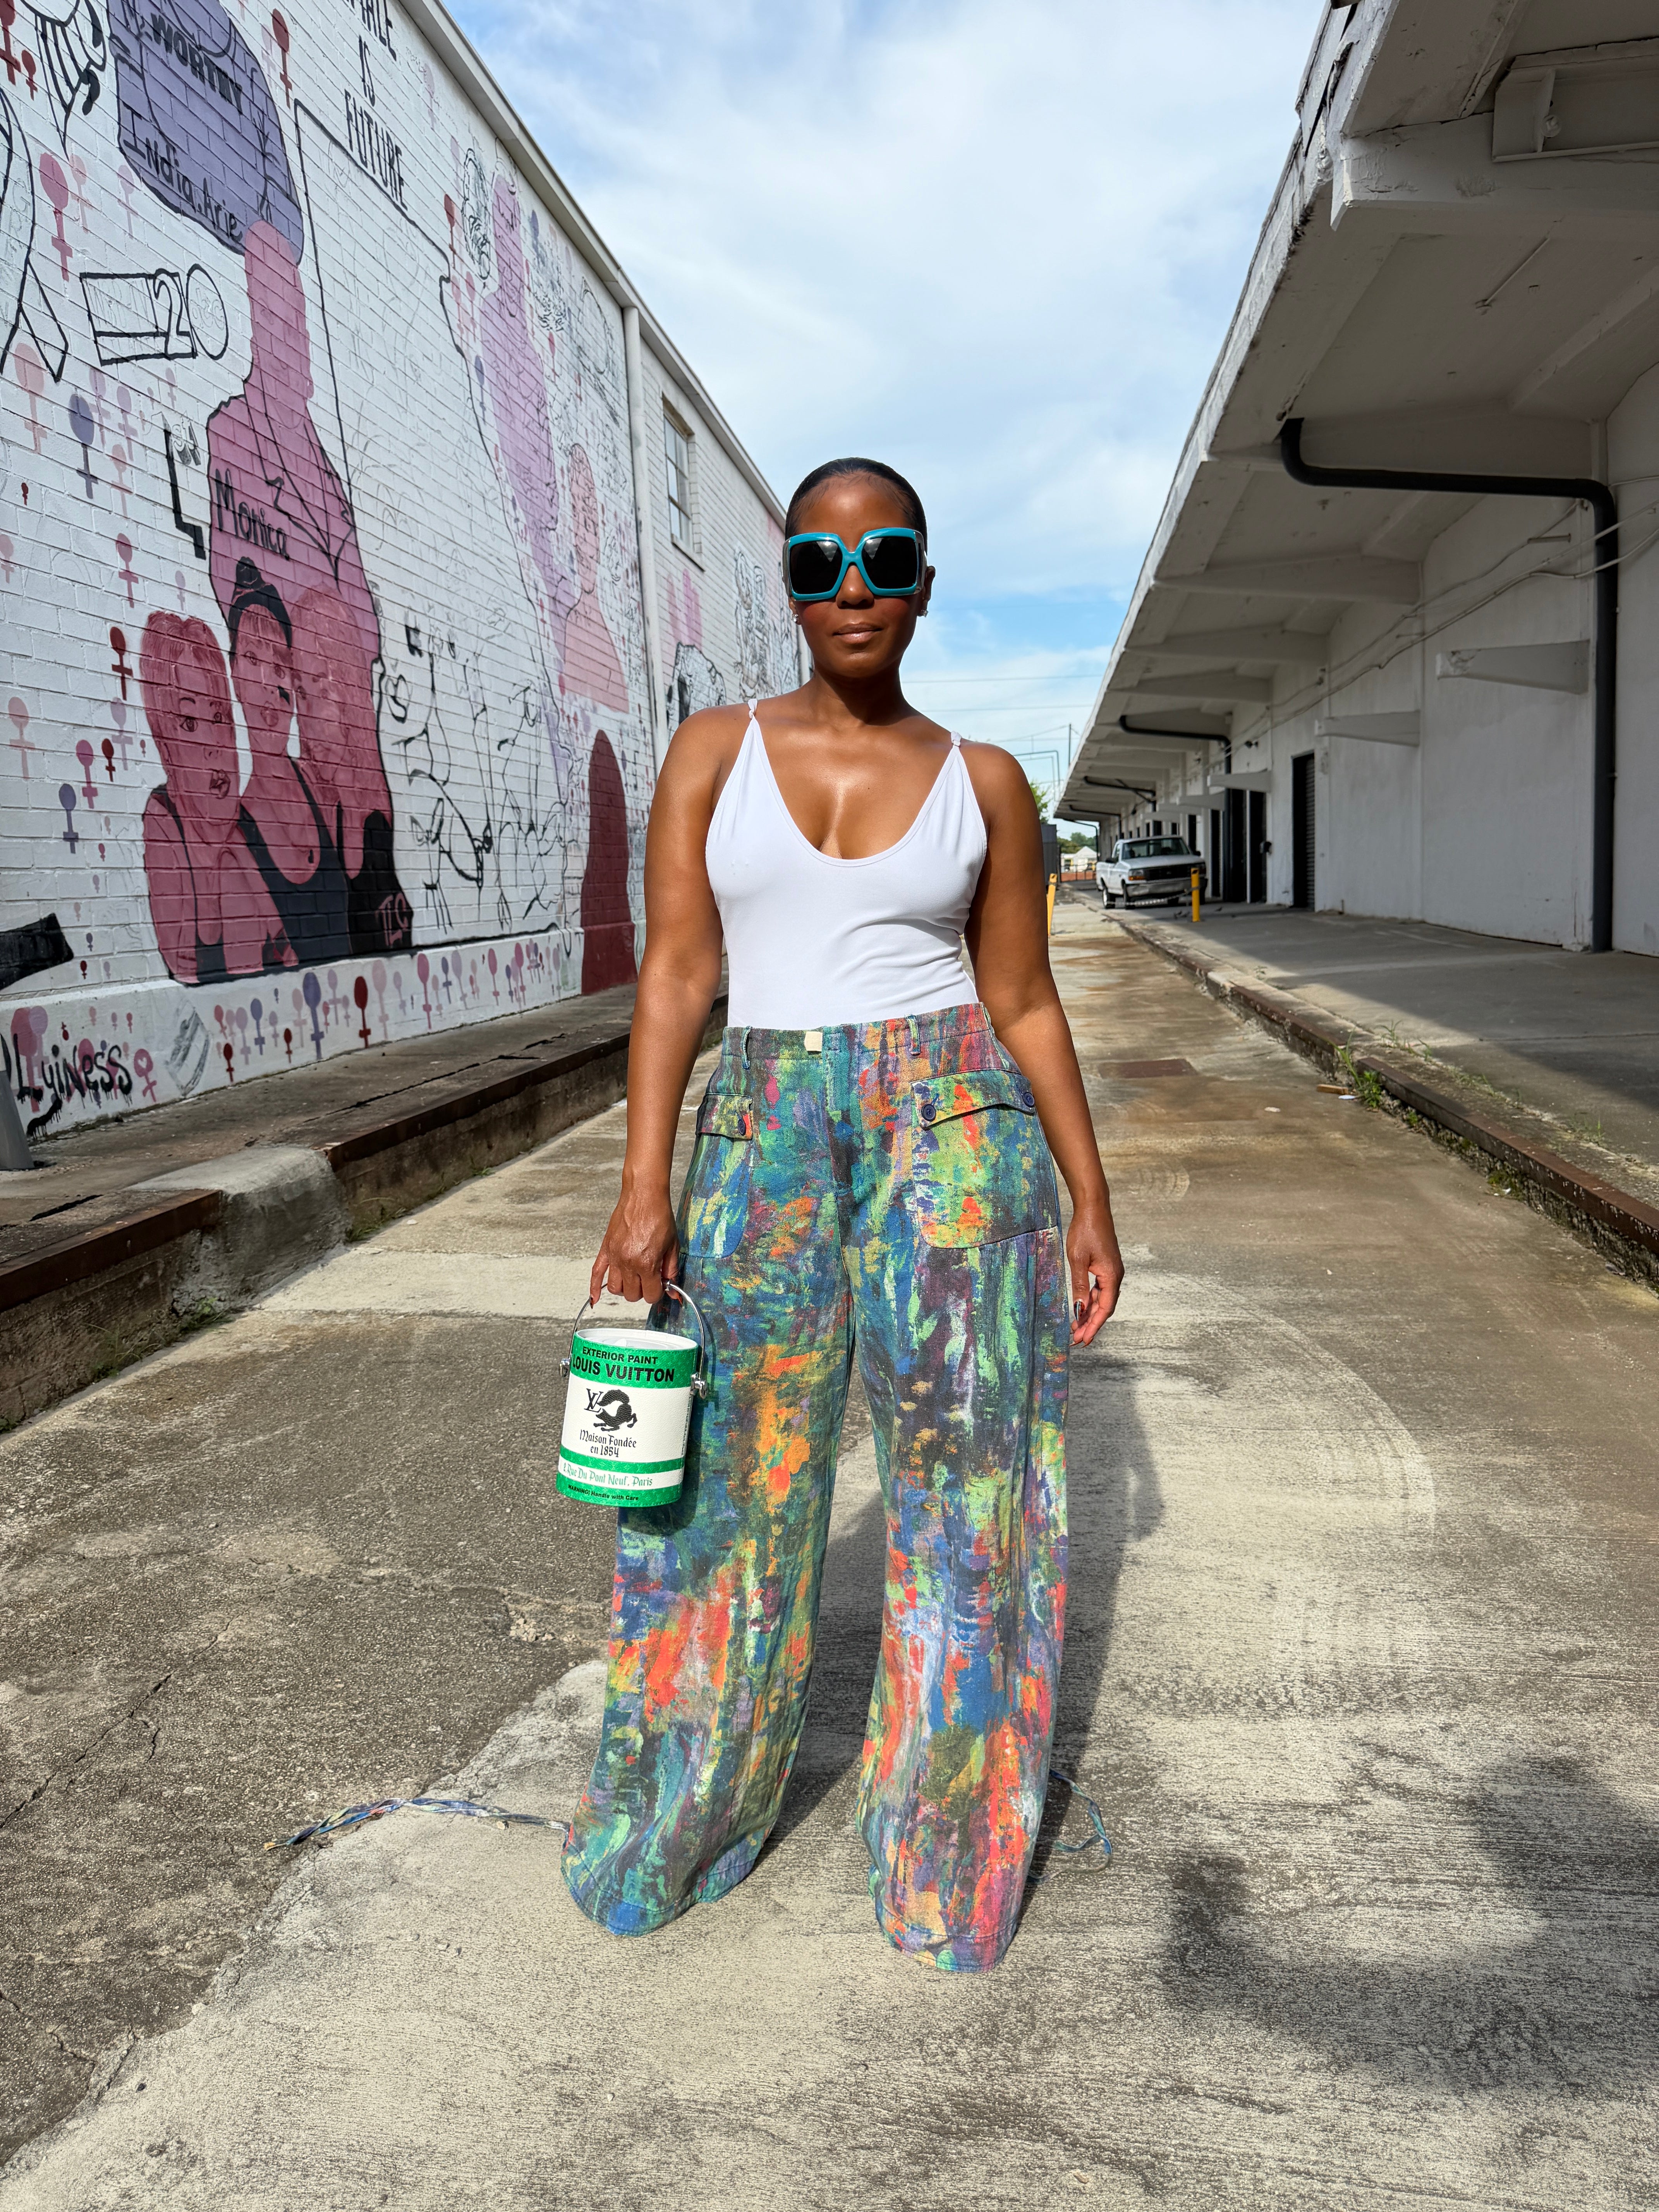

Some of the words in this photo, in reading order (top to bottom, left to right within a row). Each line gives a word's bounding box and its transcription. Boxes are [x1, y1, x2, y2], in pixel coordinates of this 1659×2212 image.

[344, 88, 408, 210] FUTURE
[215, 468, 290, 561] Monica
[582, 1346, 624, 1362] EXTERIOR
[627, 1355, 658, 1365] PAINT
[572, 1354, 601, 1376] LOUIS
[605, 1363, 675, 1382] VUITTON
[584, 1388, 604, 1413] LV
[580, 1429, 607, 1444] Maison
[608, 1434, 637, 1448] Fondée
[590, 1446, 598, 1454] en
[600, 1445, 619, 1458] 1854
[567, 1463, 577, 1477] Rue
[578, 1467, 587, 1480] Du
[589, 1470, 606, 1484] Pont
[632, 1475, 653, 1487] Paris
